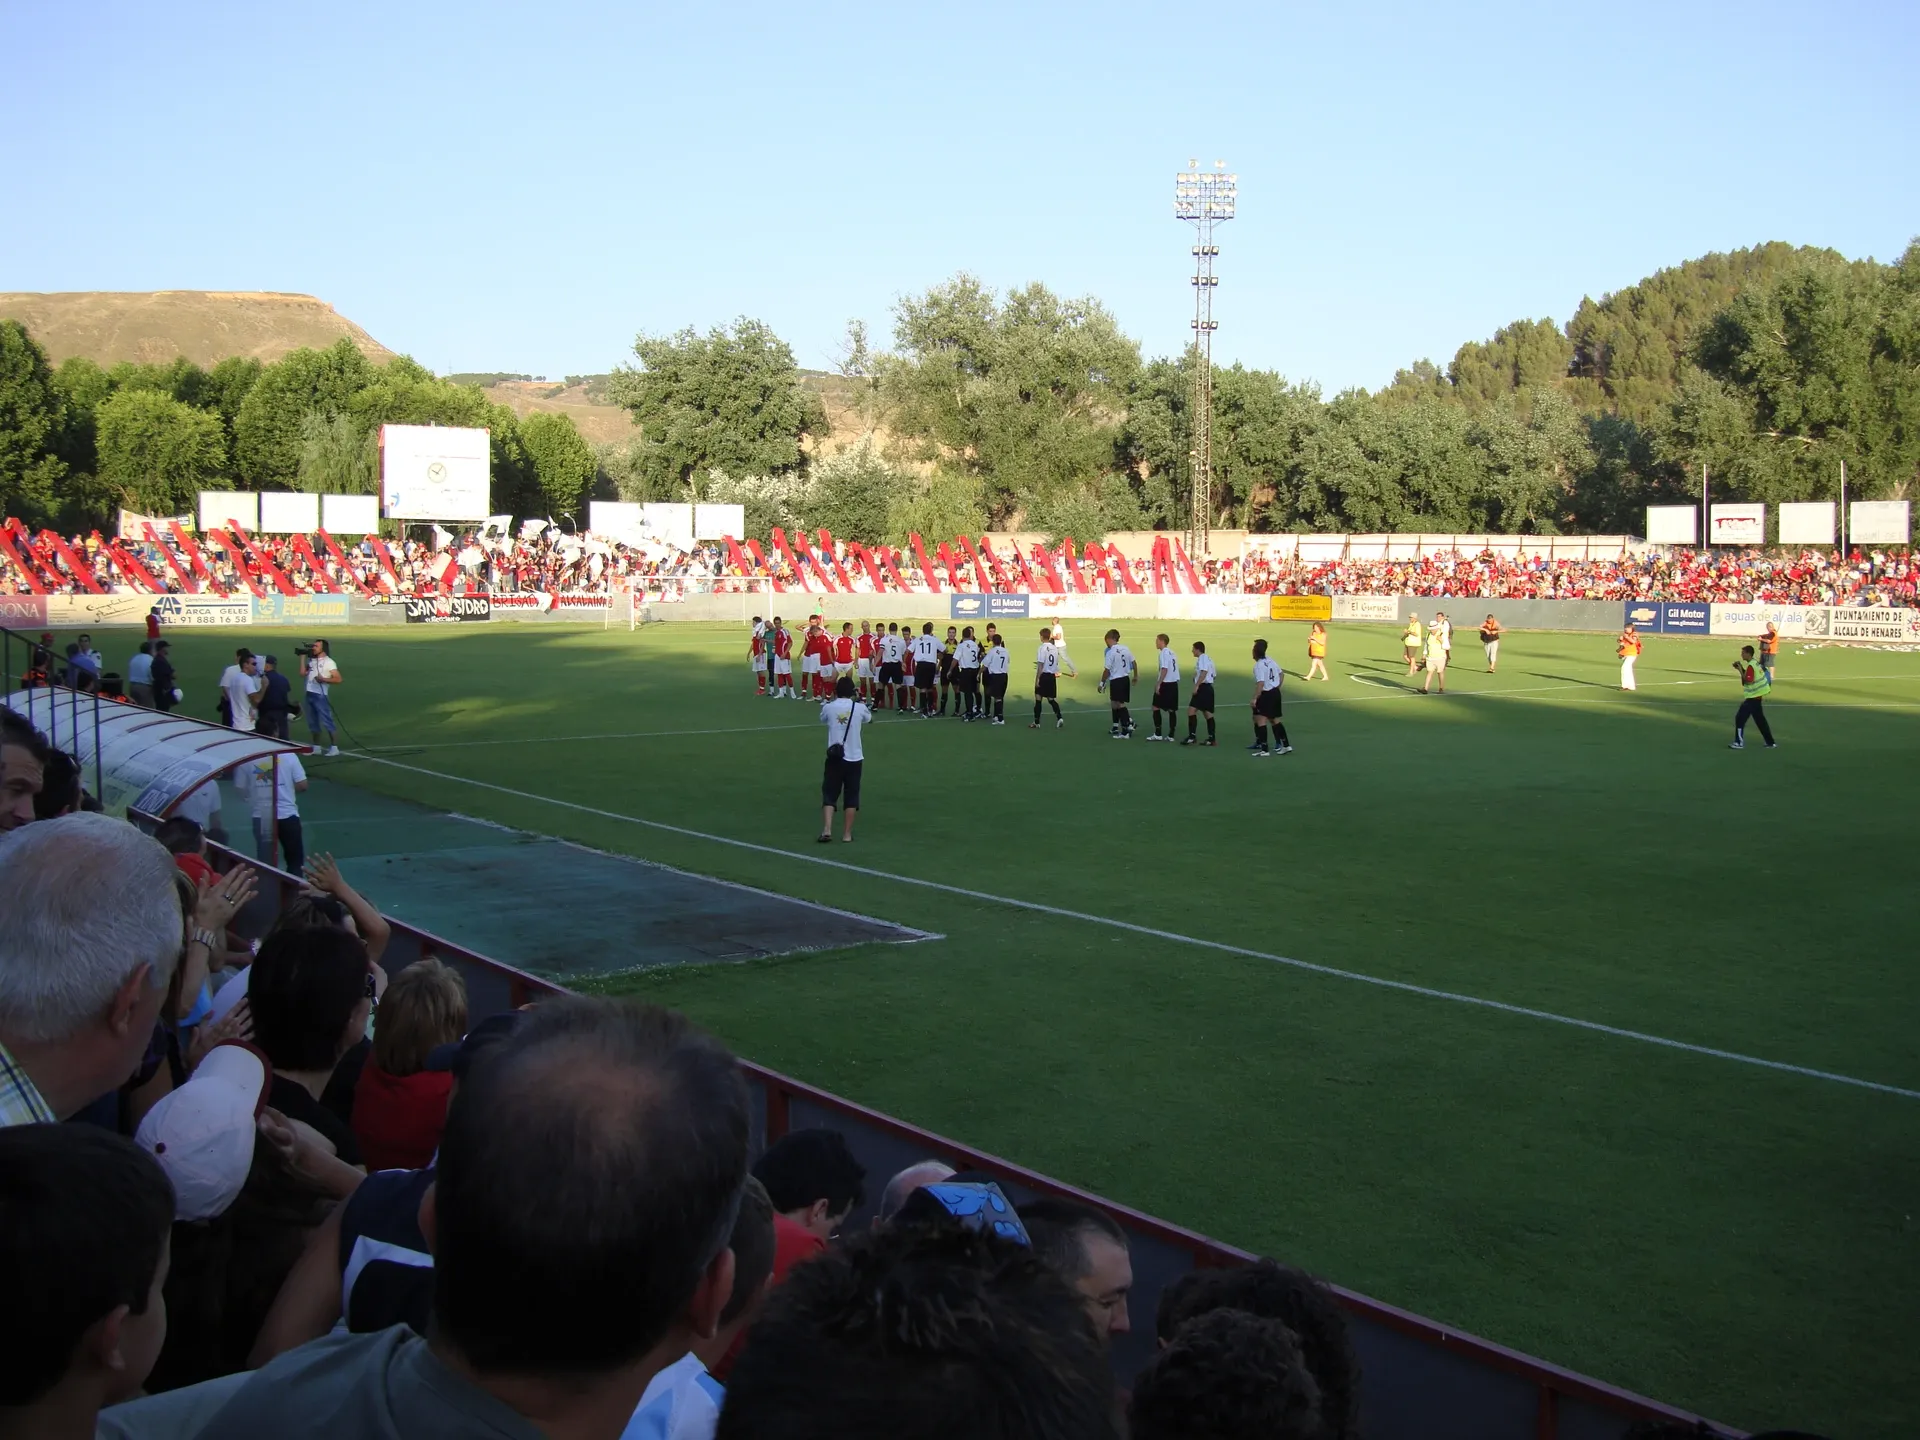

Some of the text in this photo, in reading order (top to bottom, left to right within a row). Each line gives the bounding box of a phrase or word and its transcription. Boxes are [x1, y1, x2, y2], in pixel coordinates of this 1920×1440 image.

[408, 598, 437, 616] SAN
[991, 598, 1025, 607] Gil Motor
[1351, 601, 1359, 611] El
[234, 615, 247, 623] 58
[1668, 608, 1705, 619] Gil Motor
[1724, 611, 1755, 624] aguas
[1757, 609, 1771, 622] de
[1834, 609, 1902, 622] AYUNTAMIENTO DE
[1834, 626, 1902, 638] ALCALA DE HENARES
[891, 645, 897, 657] 5
[919, 642, 931, 655] 11
[971, 650, 977, 663] 3
[999, 656, 1005, 669] 7
[1048, 653, 1055, 667] 9
[1268, 668, 1275, 682] 4
